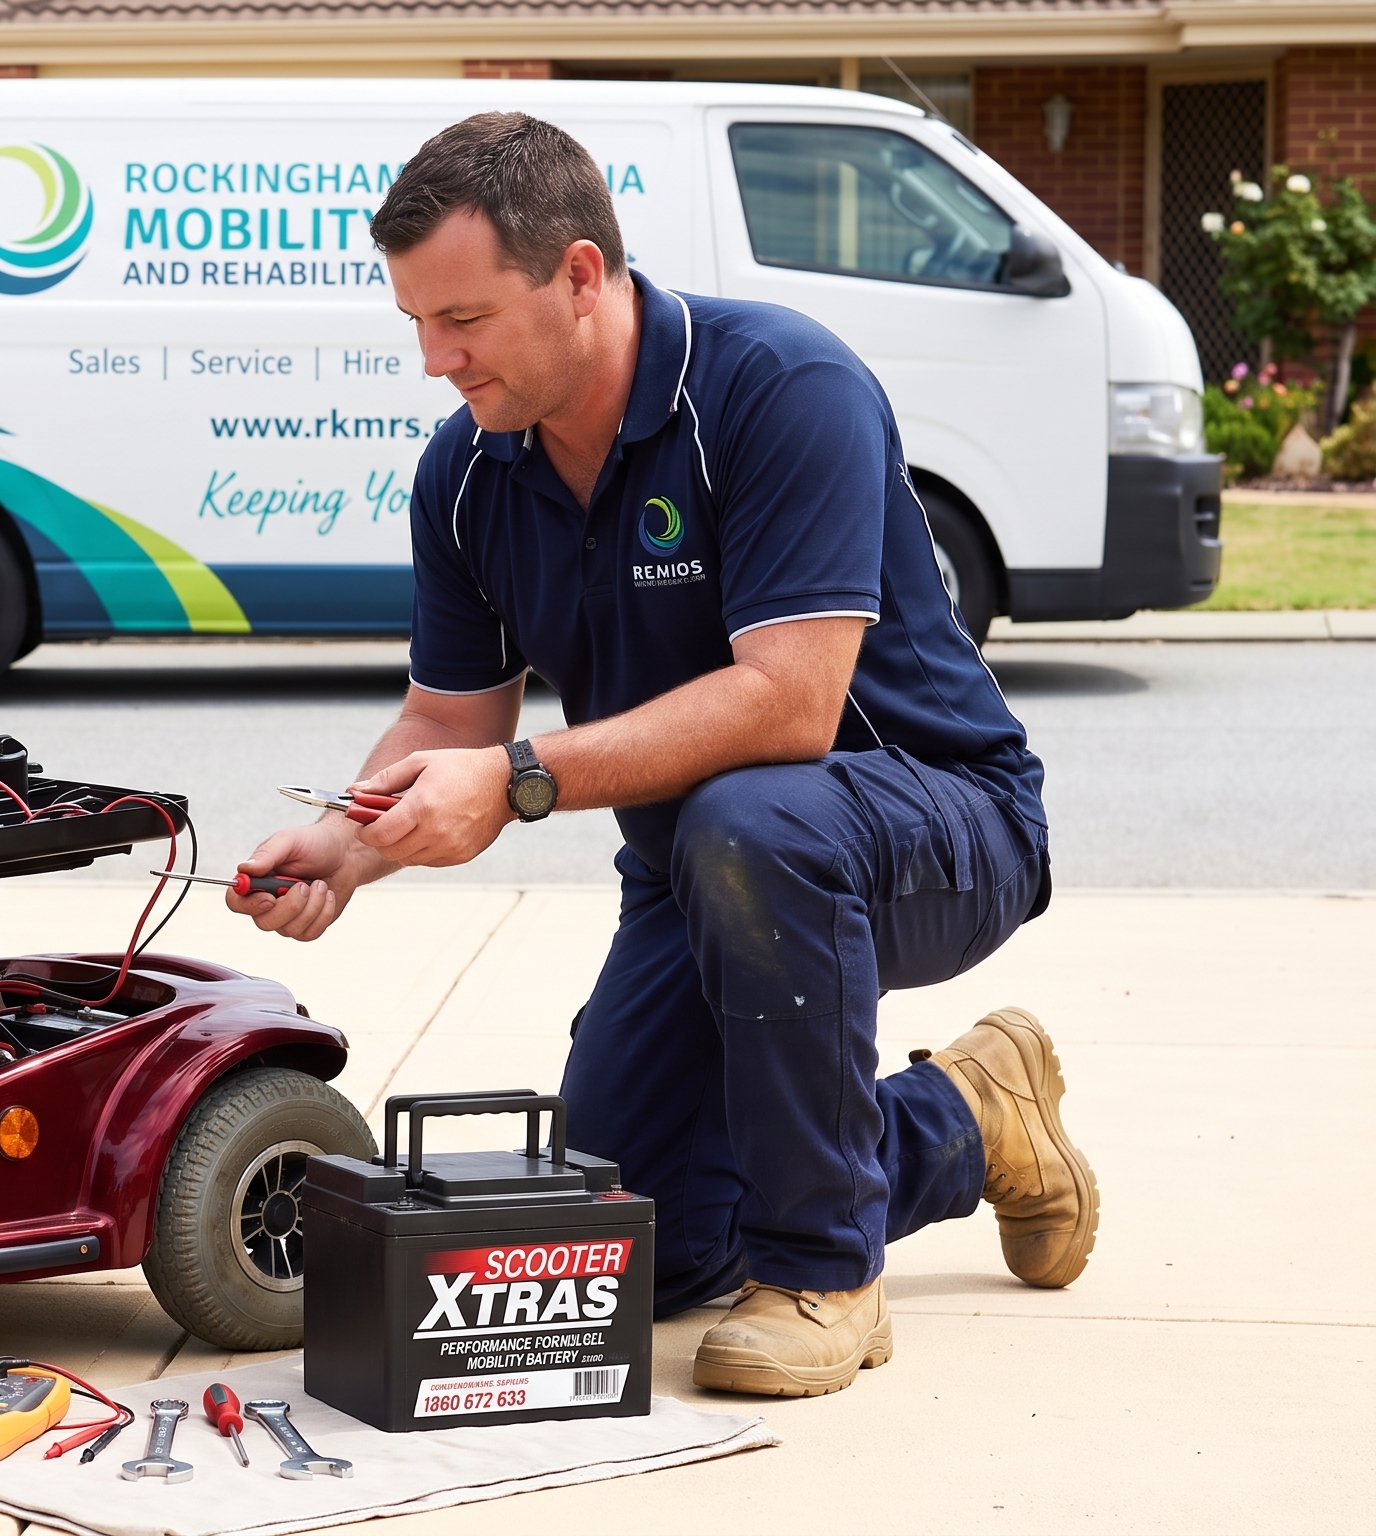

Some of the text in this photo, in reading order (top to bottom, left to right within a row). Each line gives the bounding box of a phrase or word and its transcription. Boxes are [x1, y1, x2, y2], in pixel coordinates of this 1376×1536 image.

[123, 261, 386, 286] AND REHABILITA
[69, 348, 401, 375] Sales Service Hire
[198, 469, 411, 537] Keeping Yo
[632, 559, 703, 581] REMIOS
[484, 1242, 624, 1280] SCOOTER
[416, 1271, 620, 1330] XTRAS
[439, 1336, 532, 1356] PERFORMANCE
[466, 1354, 525, 1371] MOBILITY
[525, 1349, 580, 1368] BATTERY
[463, 1392, 494, 1410] 672
[496, 1389, 527, 1408] 633
